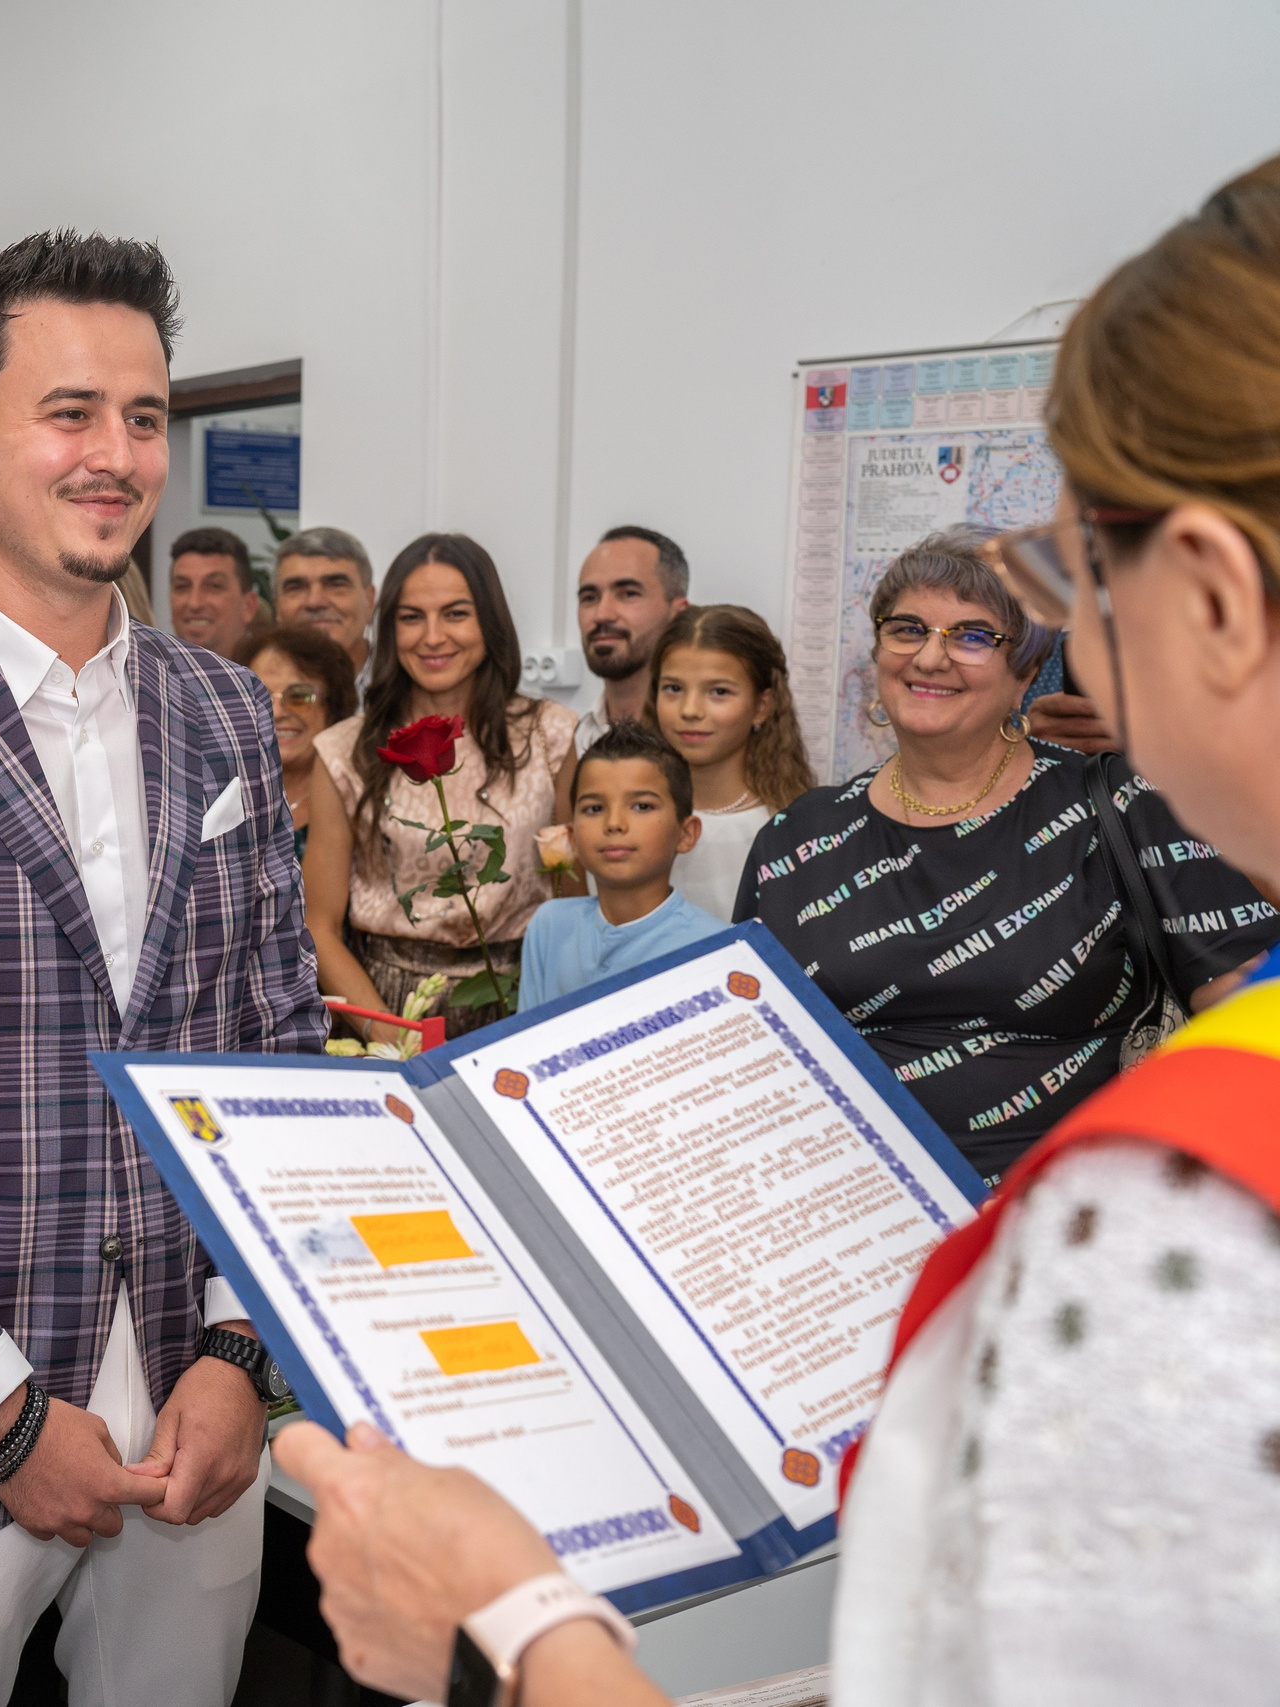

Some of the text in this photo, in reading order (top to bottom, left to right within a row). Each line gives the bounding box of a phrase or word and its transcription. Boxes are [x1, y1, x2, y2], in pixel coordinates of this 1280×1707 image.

[861, 462, 934, 478] PRAHOVA
[1024, 803, 1088, 854] ARMANI
[796, 883, 852, 926] ARMANI
[848, 870, 998, 953] ARMANI EXCHANGE
[926, 873, 1075, 977] ARMANI EXCHANGE
[1161, 909, 1228, 934] RMANI
[1014, 957, 1076, 1011] ARMANI
[1071, 900, 1122, 965] EXCHANG
[843, 983, 901, 1024] XCHANGE
[1093, 977, 1132, 1028] ARMANI
[893, 1045, 963, 1083] ARMANI
[968, 1085, 1042, 1131] ARMANI
